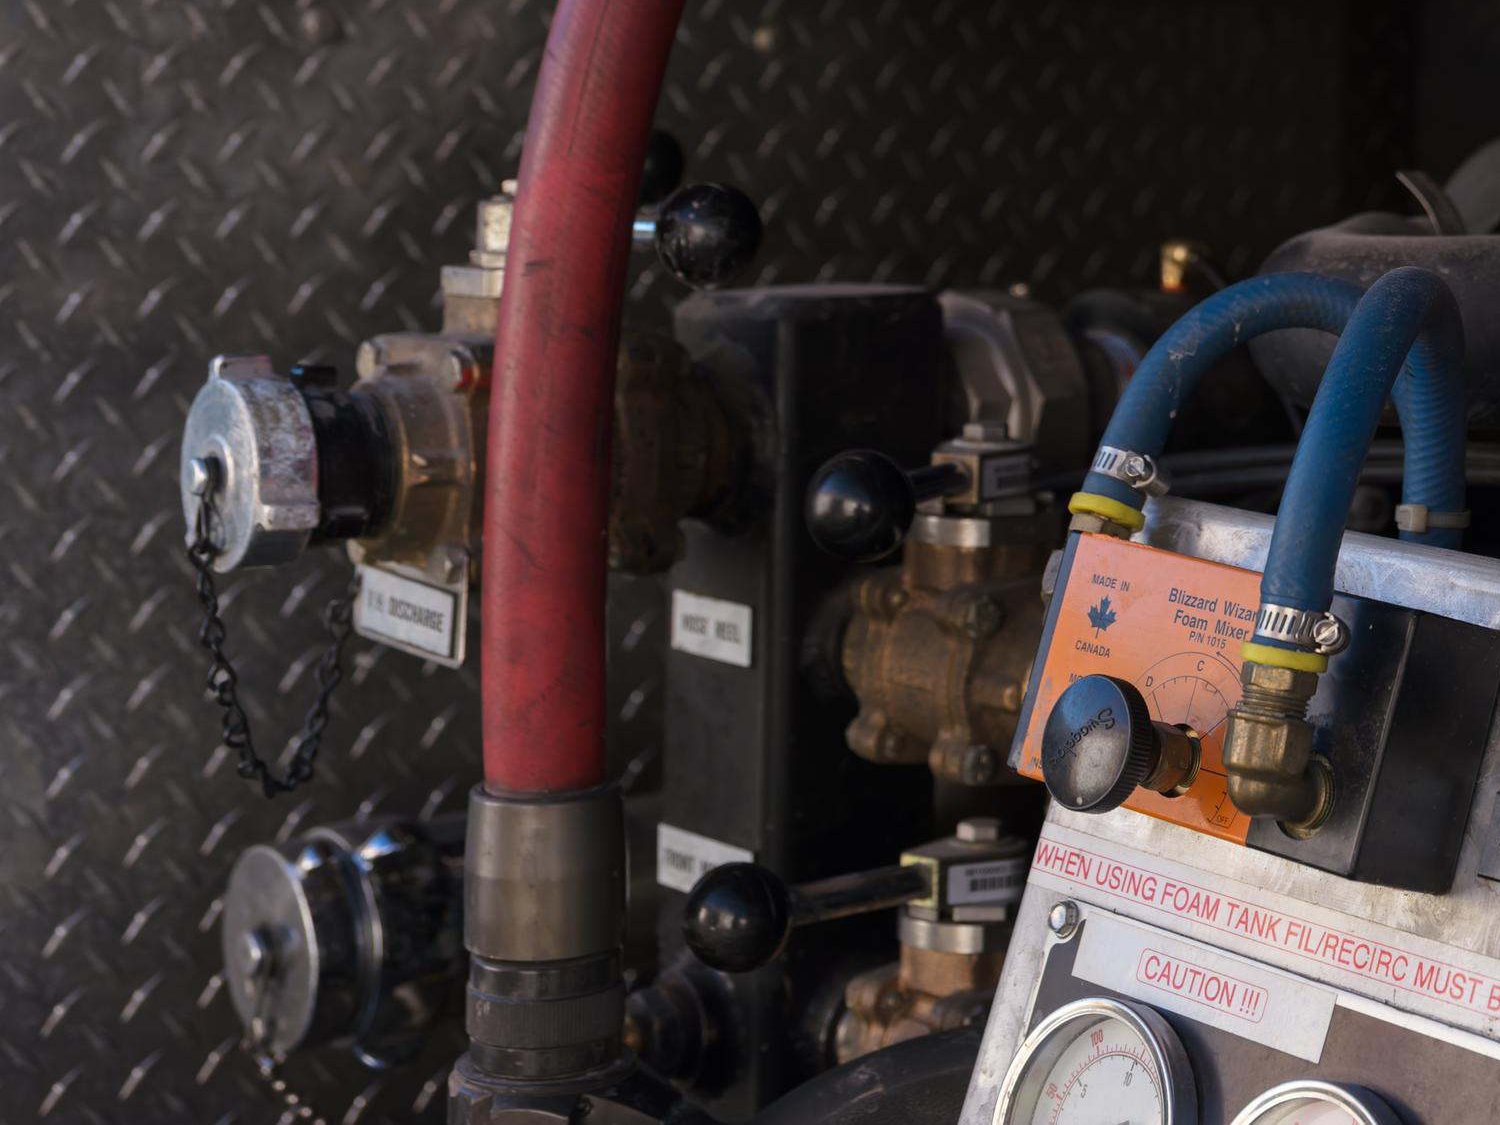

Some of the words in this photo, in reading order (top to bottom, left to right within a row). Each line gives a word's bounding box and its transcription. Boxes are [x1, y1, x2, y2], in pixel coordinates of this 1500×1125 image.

[1091, 573, 1118, 589] MADE
[1120, 581, 1131, 592] IN
[1168, 587, 1218, 613] Blizzard
[1223, 600, 1258, 622] Wizar
[1173, 609, 1208, 631] Foam
[1214, 620, 1249, 641] Mixer
[1075, 639, 1111, 658] CANADA
[1188, 631, 1206, 644] P/N
[1207, 635, 1227, 649] 1015
[1196, 660, 1205, 672] C
[1145, 676, 1154, 688] D
[1034, 841, 1094, 879] WHEN
[1095, 859, 1158, 903] USING
[1159, 885, 1221, 922] FOAM
[1225, 904, 1281, 943] TANK
[1282, 921, 1410, 984] FIL/RECIRC
[1413, 962, 1483, 1004] MUST
[1142, 953, 1238, 1006] CAUTION
[1090, 1028, 1105, 1047] 100
[1122, 1071, 1133, 1087] 10
[1046, 1082, 1058, 1100] 50
